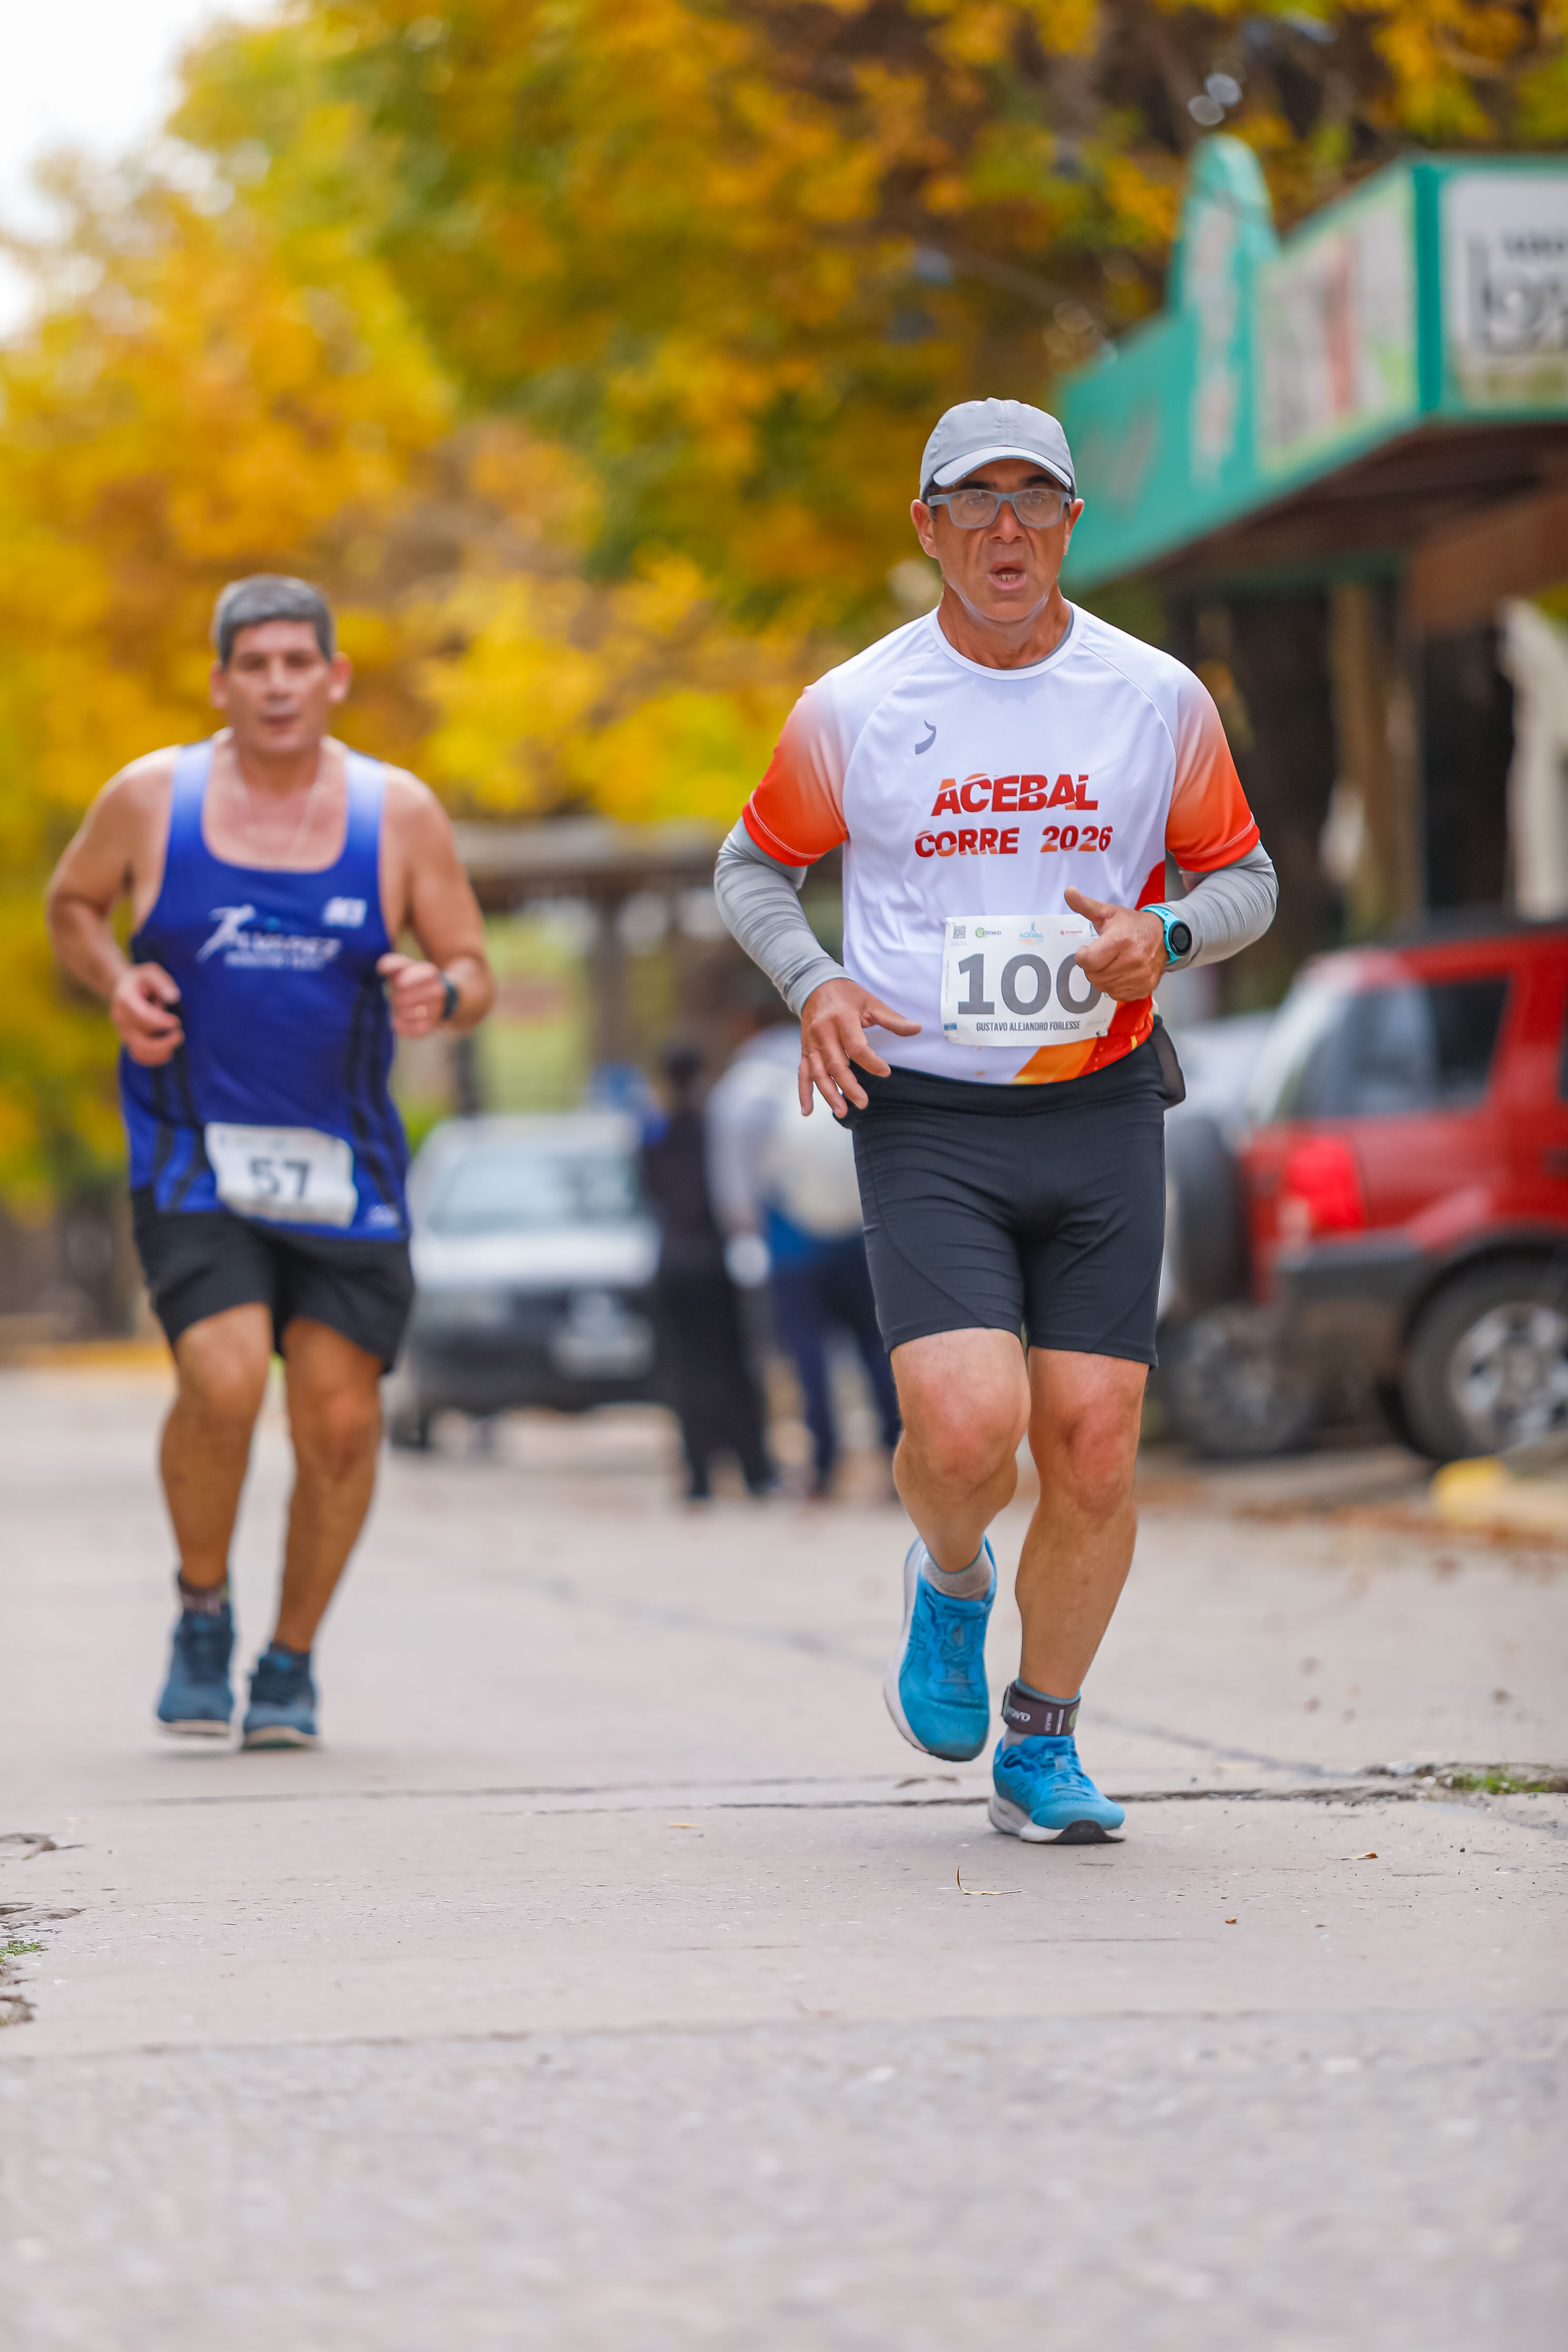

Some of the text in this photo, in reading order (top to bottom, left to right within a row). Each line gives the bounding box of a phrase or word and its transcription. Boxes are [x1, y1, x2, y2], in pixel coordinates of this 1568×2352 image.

[930, 772, 1099, 816] ACEBAL
[915, 825, 1113, 858] CORRE 2026
[958, 953, 1103, 1015] 100
[976, 1022, 1007, 1031] GUSTAVO
[1009, 1021, 1048, 1031] ALEJANDRO
[1050, 1021, 1081, 1030] FORLESSE
[250, 1157, 310, 1198] 57
